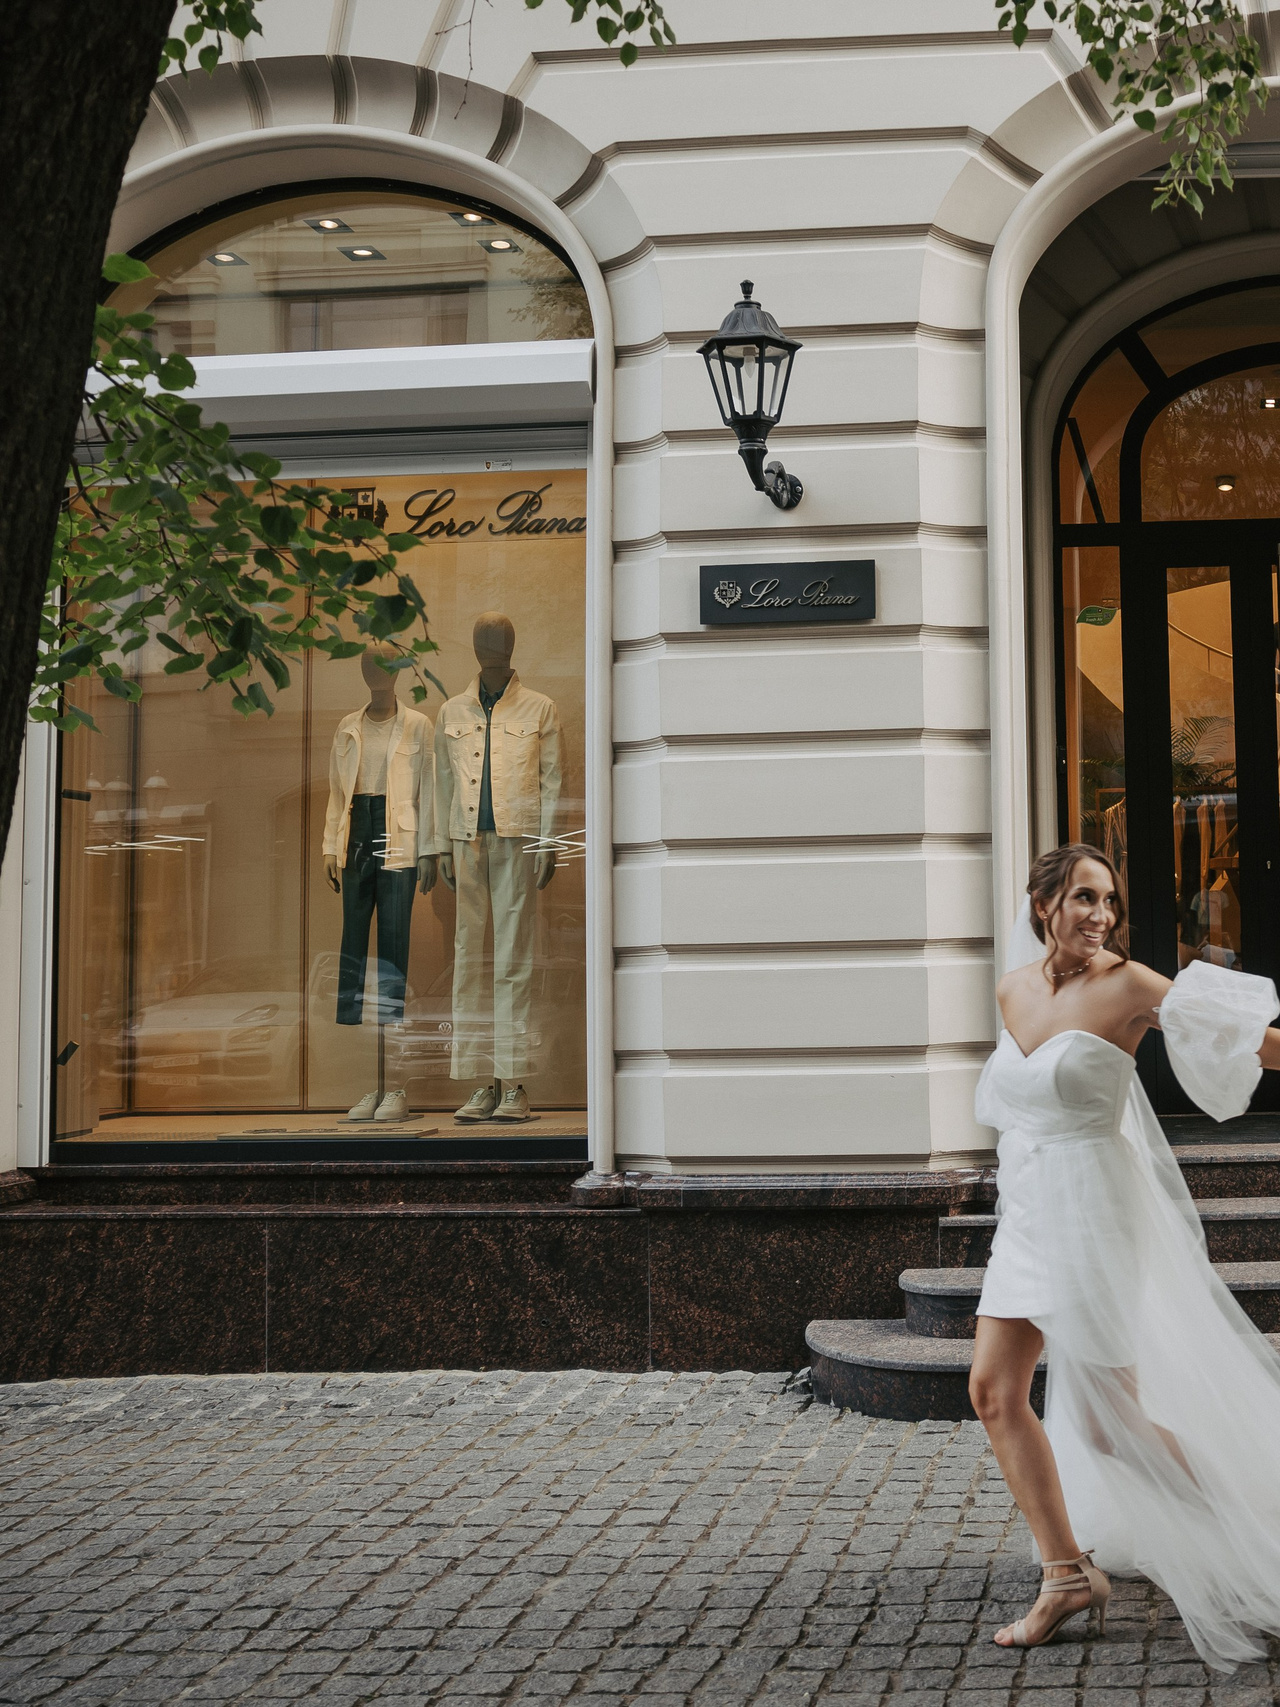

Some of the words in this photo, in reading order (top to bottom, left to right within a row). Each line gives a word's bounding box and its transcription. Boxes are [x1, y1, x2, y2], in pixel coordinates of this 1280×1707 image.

[389, 488, 485, 538] Loro
[488, 483, 587, 535] Piana
[741, 578, 797, 608] Loro
[798, 575, 860, 607] Piana
